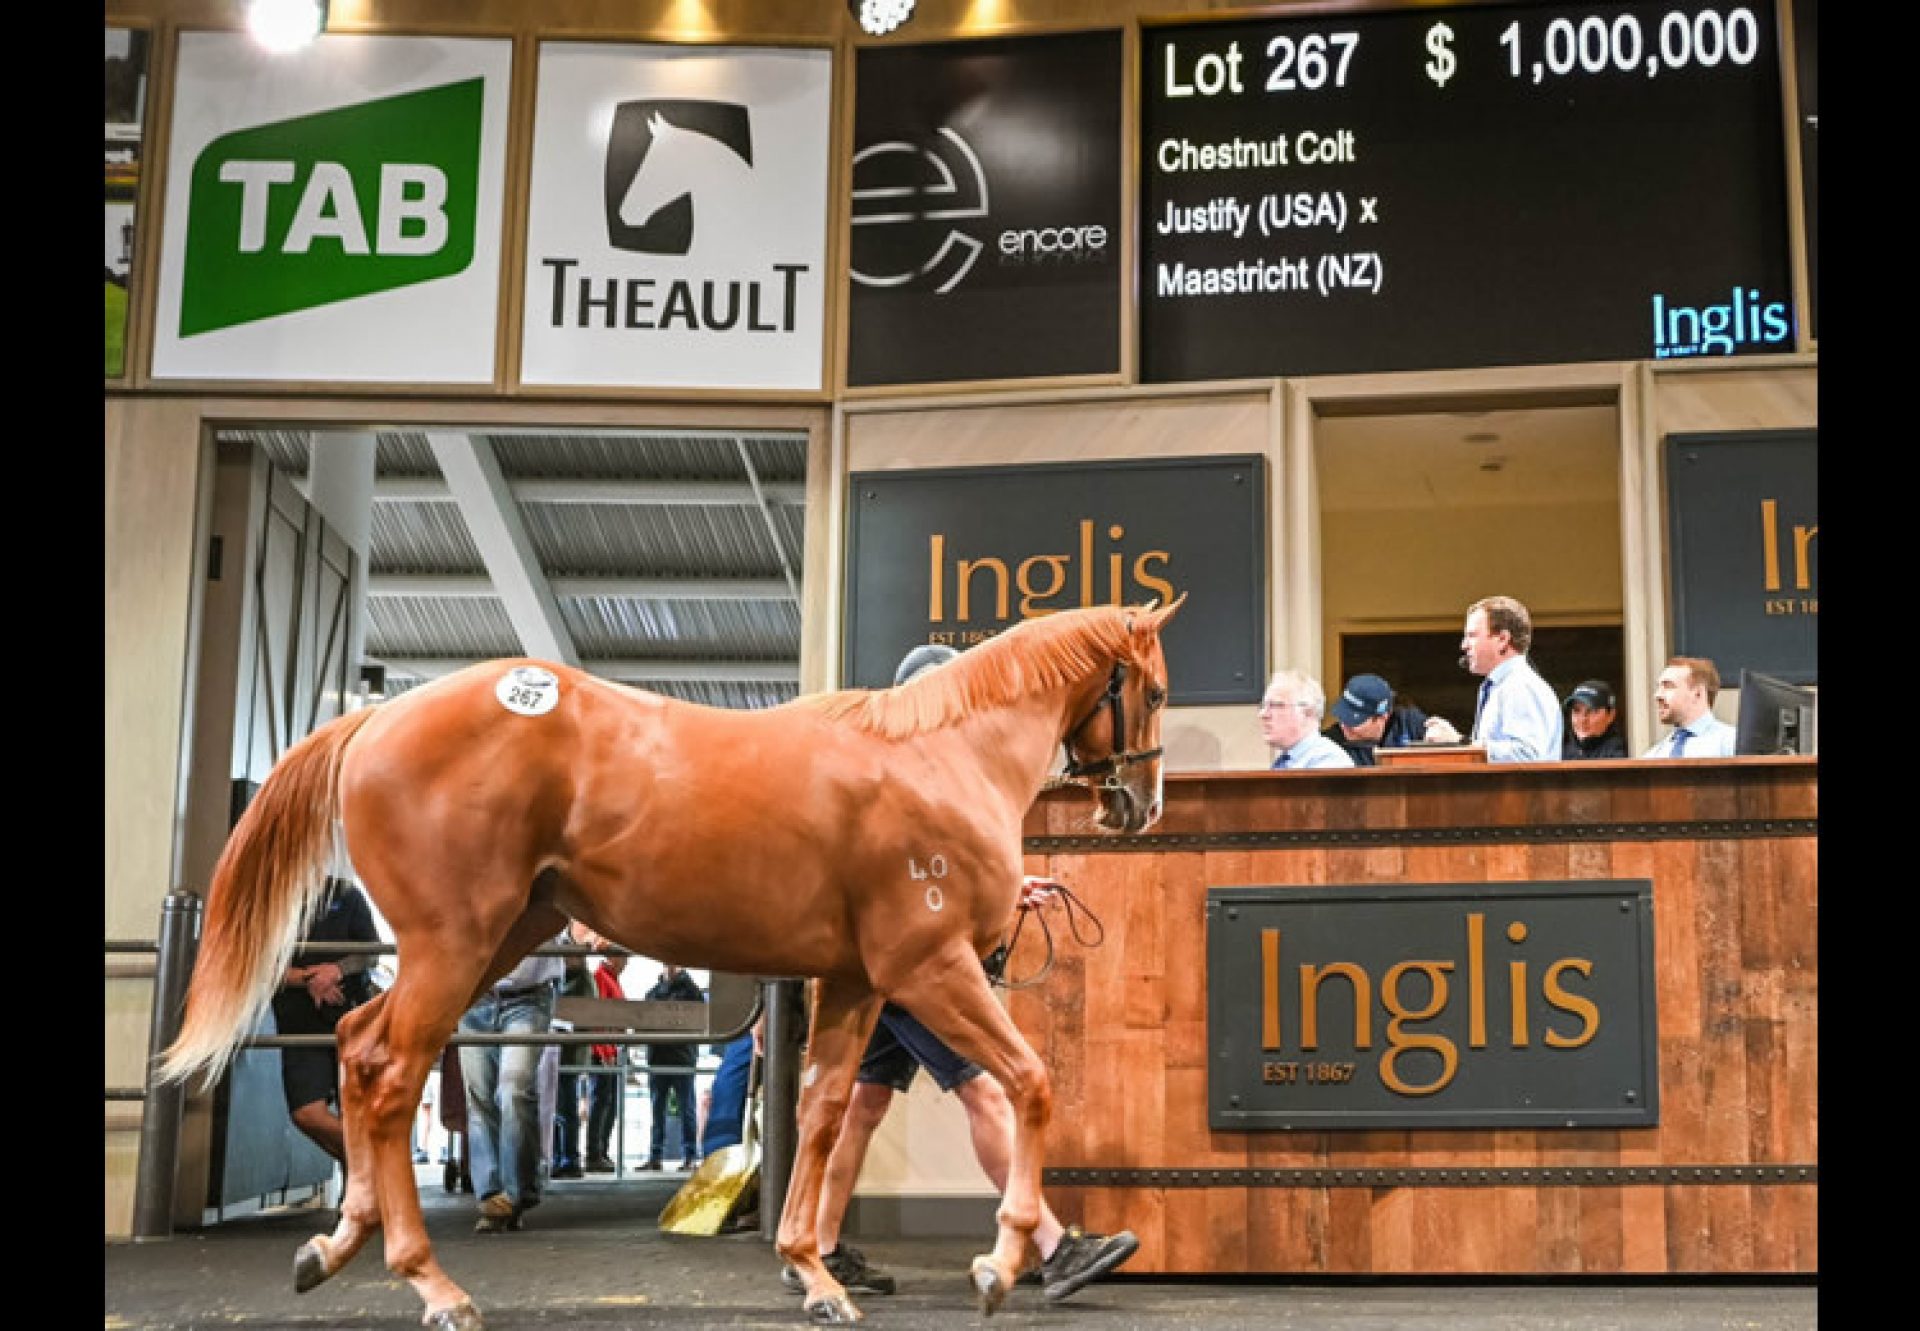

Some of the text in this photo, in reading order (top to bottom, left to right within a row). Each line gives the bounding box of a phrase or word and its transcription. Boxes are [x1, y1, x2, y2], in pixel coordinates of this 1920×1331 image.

[1164, 8, 1758, 98] Lot 267 $ 1,000,000
[1157, 129, 1356, 172] Chestnut Colt
[219, 160, 449, 256] TAB
[1156, 191, 1379, 239] Justify (USA) x
[998, 225, 1108, 254] encore
[1157, 252, 1383, 297] Maastricht (NZ)
[1653, 286, 1788, 354] Inglis
[508, 685, 543, 709] 267
[1261, 913, 1600, 1096] Inglis
[1262, 1061, 1356, 1083] EST 1867
